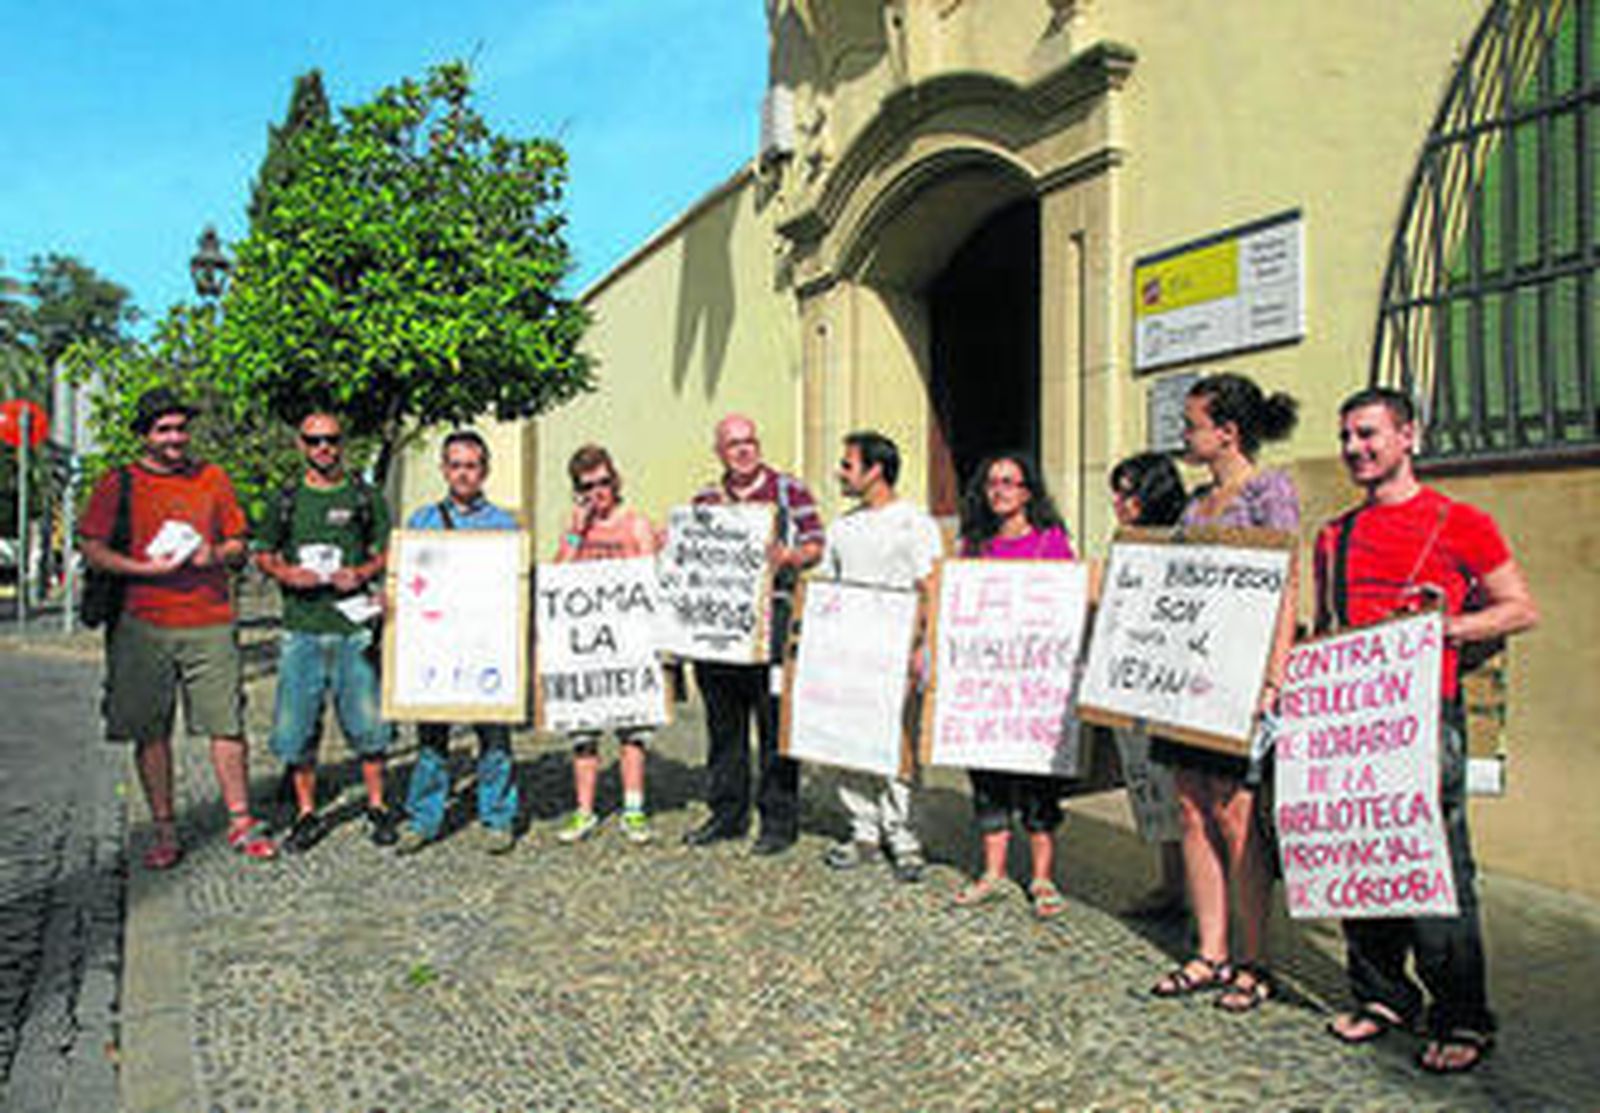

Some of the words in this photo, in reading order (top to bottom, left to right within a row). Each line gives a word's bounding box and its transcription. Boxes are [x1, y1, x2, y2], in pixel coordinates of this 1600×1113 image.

[540, 581, 655, 619] TOMA
[1150, 595, 1207, 624] SON
[570, 624, 618, 655] LA
[1283, 633, 1389, 684] CONTRA
[1398, 621, 1438, 660] LA
[1308, 715, 1419, 758] HORARIO
[1279, 792, 1433, 836] BIBLIOTECA
